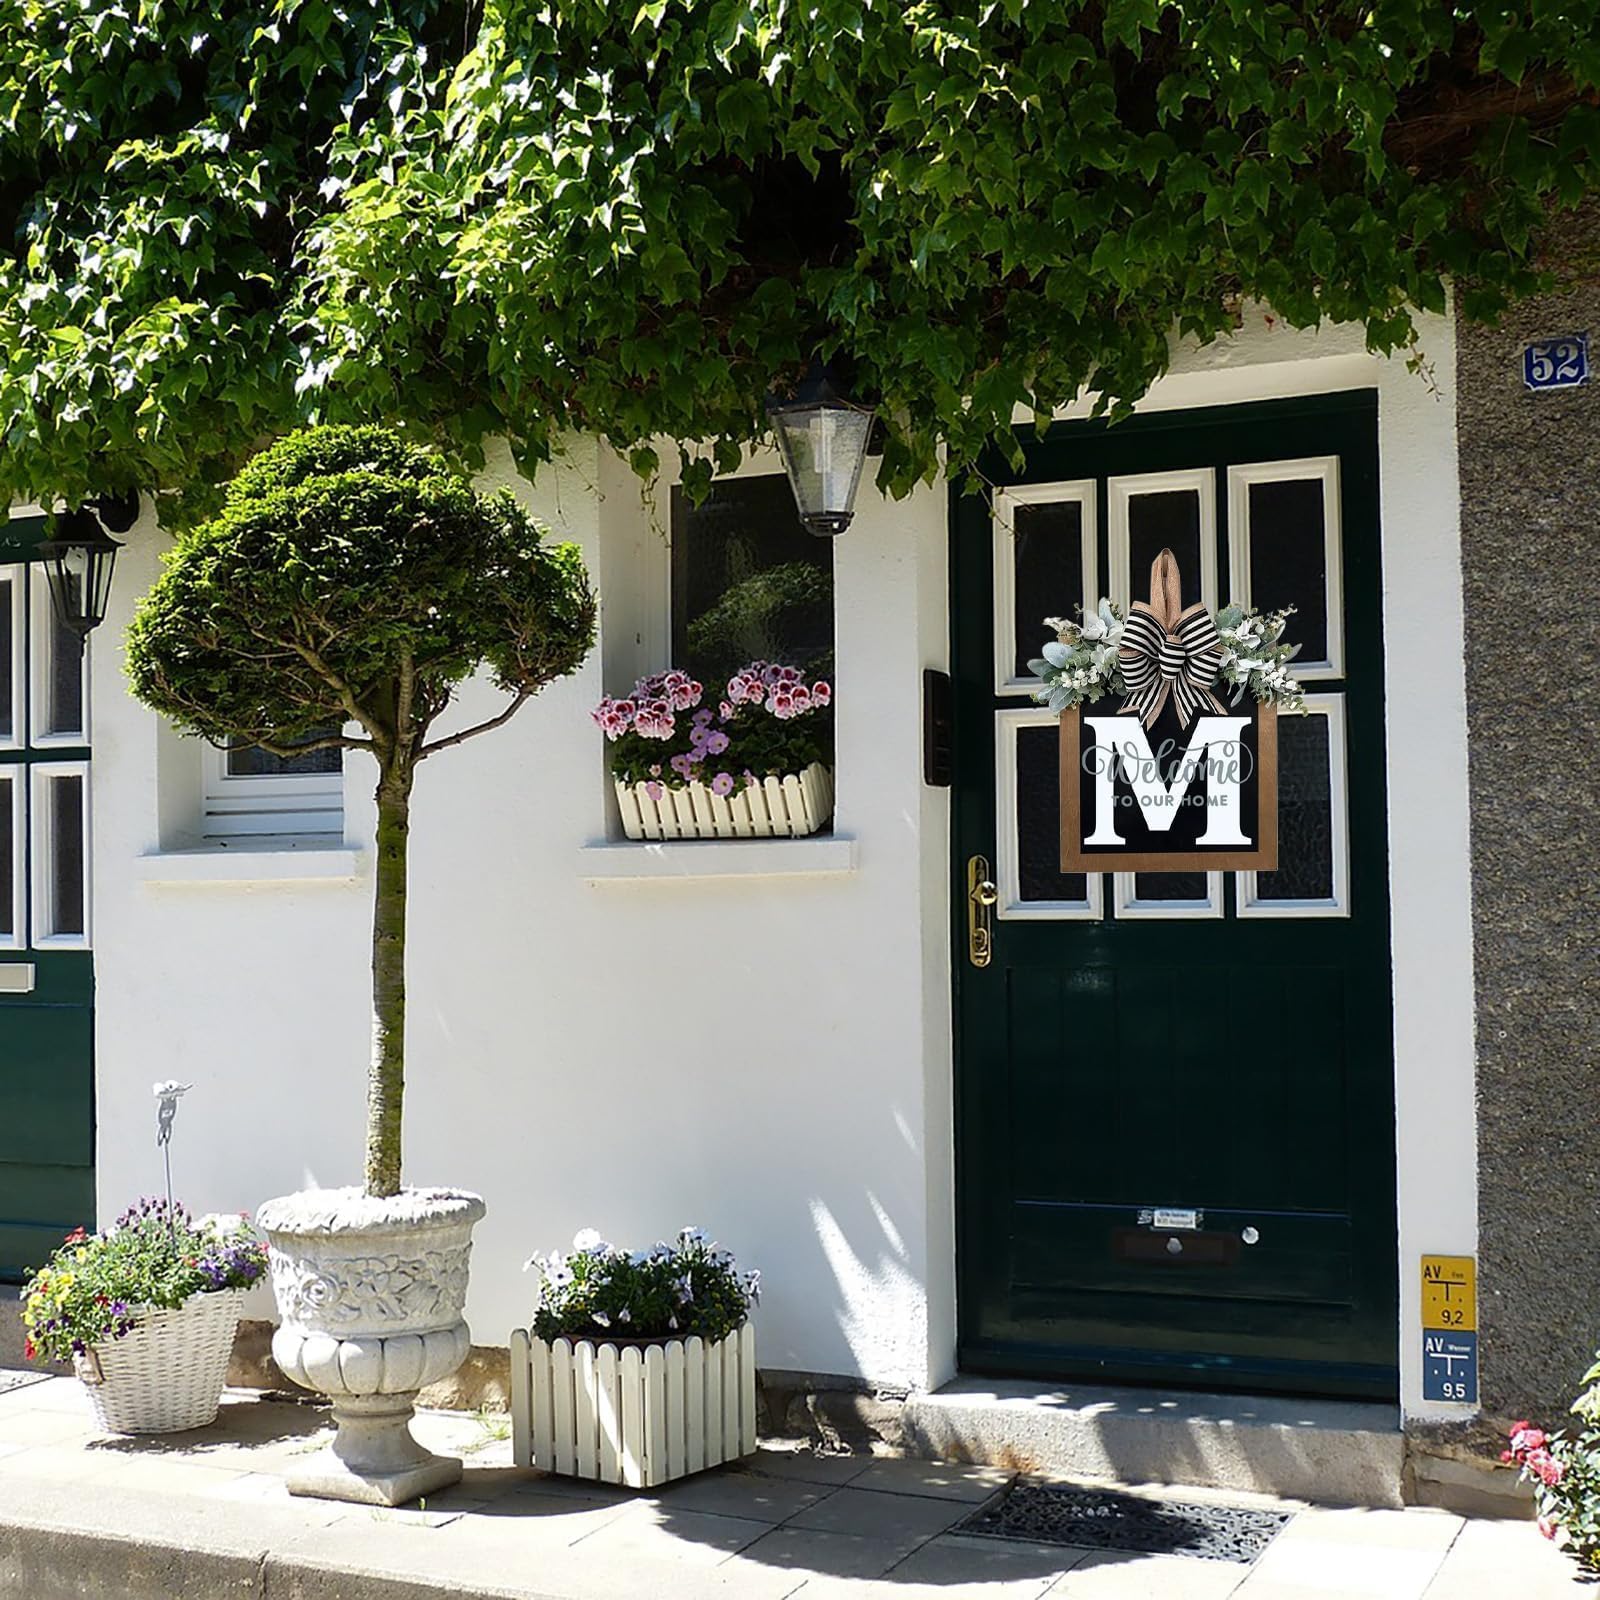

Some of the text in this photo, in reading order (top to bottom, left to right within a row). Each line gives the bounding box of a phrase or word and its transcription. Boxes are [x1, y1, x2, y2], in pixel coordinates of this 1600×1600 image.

[1532, 343, 1579, 381] 52
[1081, 738, 1254, 785] Welcome
[1083, 716, 1252, 845] M
[1111, 795, 1229, 807] TO OUR HOME
[1423, 1264, 1442, 1279] AV
[1425, 1336, 1444, 1352] AV
